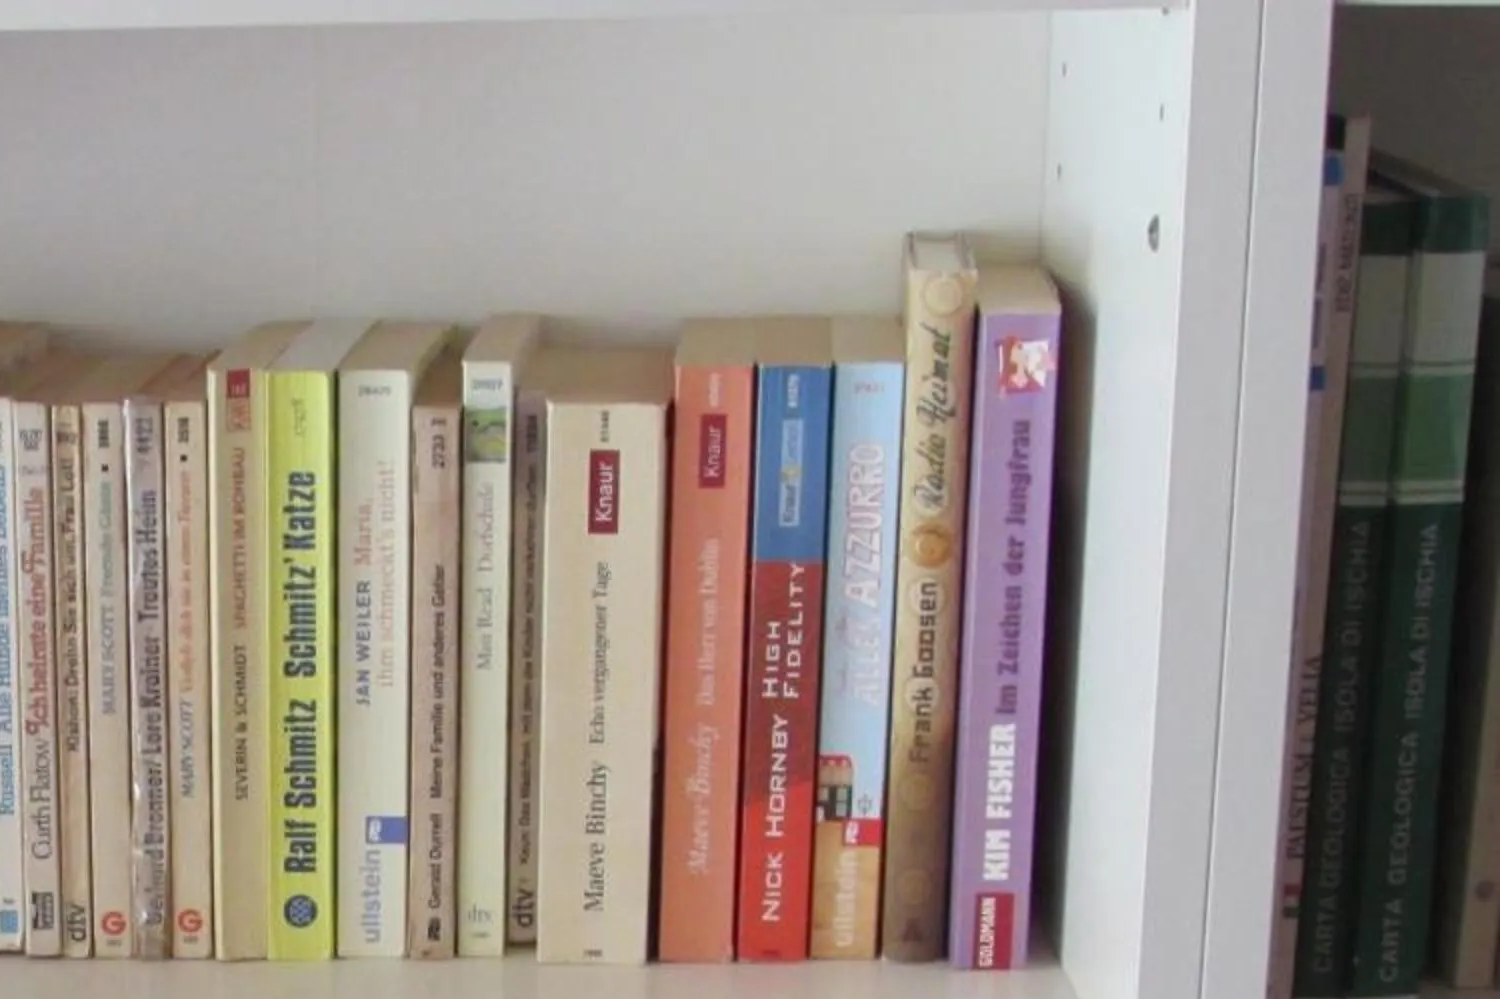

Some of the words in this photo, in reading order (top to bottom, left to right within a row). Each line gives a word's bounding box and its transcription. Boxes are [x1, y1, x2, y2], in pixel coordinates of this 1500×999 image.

[914, 325, 951, 420] Heimat
[231, 447, 246, 515] ROHBAU
[705, 425, 724, 478] Knaur
[912, 433, 947, 512] Radio
[1001, 418, 1034, 526] Jungfrau
[233, 520, 246, 540] IM
[284, 472, 317, 551] Katze
[594, 461, 615, 523] Knaur
[782, 483, 798, 523] Knaur
[843, 442, 885, 608] AZZURRO
[354, 498, 375, 567] Maria,
[1001, 537, 1028, 577] der
[1343, 520, 1369, 611] ISCHIA
[1413, 524, 1440, 608] ISCHIA
[233, 542, 247, 630] SPAGHETTI
[282, 554, 317, 678] Schmitz'
[592, 561, 612, 599] Tage
[355, 579, 372, 662] WEILER
[590, 603, 611, 703] vergangener
[783, 561, 806, 699] FIDELITY
[912, 581, 938, 680] Goosen
[995, 585, 1026, 675] Zeichen
[1339, 620, 1363, 647] DI
[1410, 615, 1430, 640] DI
[234, 644, 248, 717] SCHMIDT
[355, 668, 372, 706] JAN
[762, 621, 782, 699] HIGH
[855, 615, 882, 706] ALLES
[1332, 655, 1360, 732] ISOLA
[1403, 647, 1429, 719] ISOLA
[234, 721, 248, 734] &
[588, 707, 606, 745] Echo
[909, 687, 935, 764] Frank
[995, 684, 1019, 716] Im
[234, 739, 248, 801] SEVERIN
[283, 699, 318, 810] Schmitz
[766, 715, 789, 837] HORNBY
[983, 723, 1018, 819] FISHER
[586, 763, 612, 836] Binchy
[1318, 746, 1352, 888] GEOLOGICA
[1387, 732, 1420, 885] GEOLOGICA
[285, 820, 317, 874] Ralf
[585, 841, 607, 912] Maeve
[981, 828, 1012, 882] KIM
[64, 903, 88, 942] dtv
[358, 848, 384, 943] ullstein
[513, 888, 535, 928] dtv
[761, 852, 783, 922] NICK
[834, 849, 858, 948] ullstein
[977, 896, 998, 968] GOLDMANN
[1313, 892, 1336, 974] CARTA
[1378, 898, 1405, 983] CARTA
